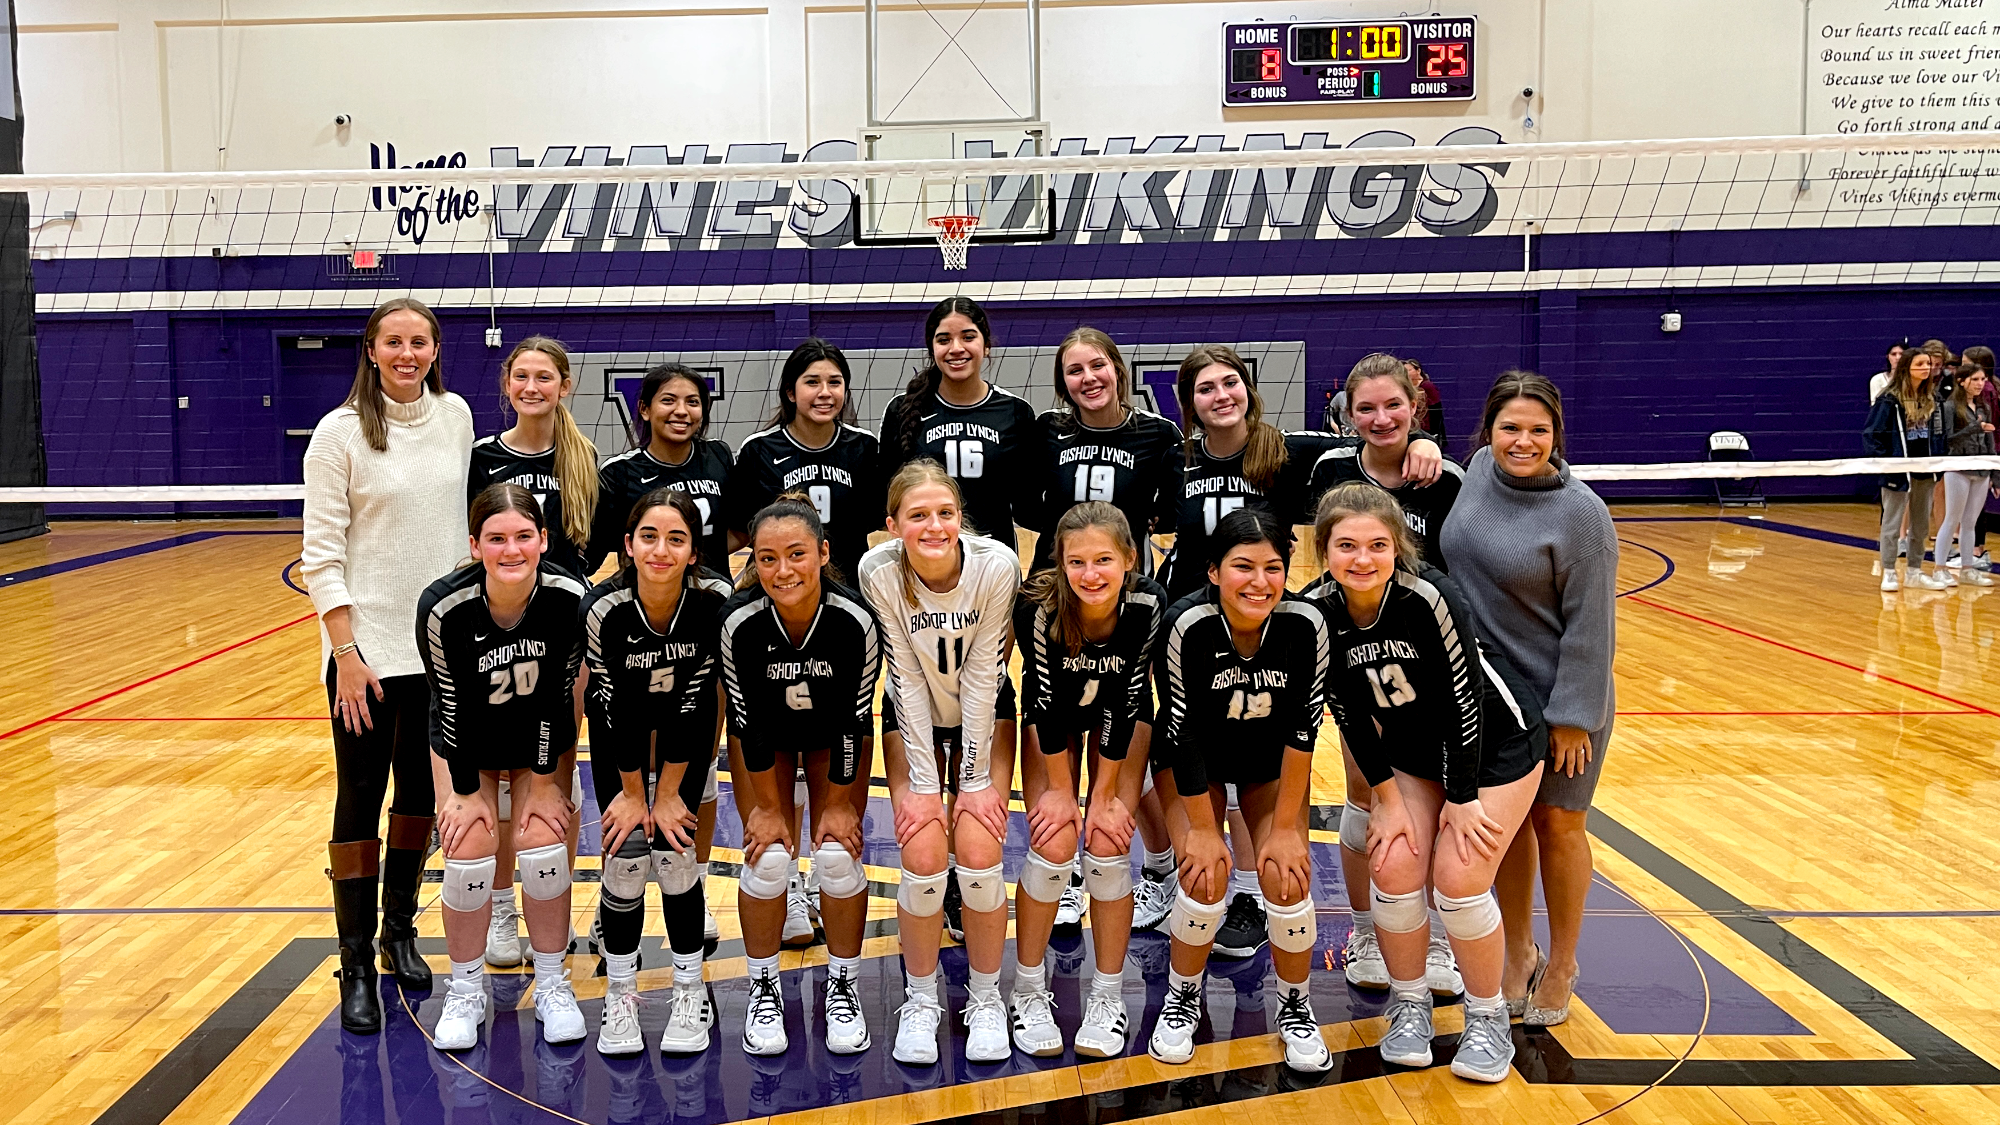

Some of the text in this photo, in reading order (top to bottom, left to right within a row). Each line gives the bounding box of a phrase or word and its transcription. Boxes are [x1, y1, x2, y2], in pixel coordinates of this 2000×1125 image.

[1235, 28, 1279, 44] HOME
[1413, 23, 1472, 39] VISITOR
[1821, 25, 1851, 38] Our
[1856, 23, 1902, 37] hearts
[1908, 21, 1952, 36] recall
[1954, 21, 1987, 35] each
[1330, 27, 1401, 59] 1:00
[1820, 46, 1875, 62] Bound
[1877, 50, 1894, 61] us
[1899, 47, 1914, 60] in
[1919, 48, 1961, 60] sweet
[1261, 50, 1280, 80] 8
[1327, 67, 1348, 76] POSS
[1427, 45, 1466, 76] 25
[1318, 77, 1358, 89] PERIOD
[1373, 71, 1379, 96] 1
[1411, 82, 1448, 95] BONUS
[1822, 72, 1884, 86] Because
[1888, 74, 1911, 84] we
[1916, 69, 1947, 84] love
[1952, 73, 1978, 83] our
[1250, 86, 1287, 98] BONUS
[1832, 94, 1857, 109] We
[1861, 95, 1893, 113] give
[1899, 96, 1914, 108] to
[1920, 92, 1956, 107] them
[1962, 92, 1990, 106] this
[1837, 119, 1858, 134] Go
[1864, 116, 1902, 133] forth
[1961, 115, 1992, 131] and
[1829, 166, 1889, 180] Forever
[1888, 163, 1957, 183] faithful
[1958, 166, 1980, 178] we
[490, 127, 1508, 245] VINES VIKINGS
[1840, 189, 1883, 203] Vines
[1888, 188, 1948, 206] Vikings
[397, 186, 479, 245] of the
[926, 422, 999, 444] BISHOP LYNCH
[944, 440, 983, 478] 16
[1059, 445, 1134, 469] BISHOP LYNCH
[537, 474, 561, 490] LYNC
[686, 479, 721, 496] LYNCH
[784, 465, 852, 490] BISHOP LYNCH
[1074, 464, 1115, 503] 19
[1186, 476, 1264, 498] BISHOP LYNC
[808, 485, 830, 523] 9
[1403, 511, 1426, 536] NCH
[937, 635, 964, 675] 11
[1099, 655, 1126, 673] LYNC
[489, 660, 539, 704] 20
[648, 666, 675, 693] 5
[1366, 664, 1416, 707] 13
[539, 721, 550, 740] LADY
